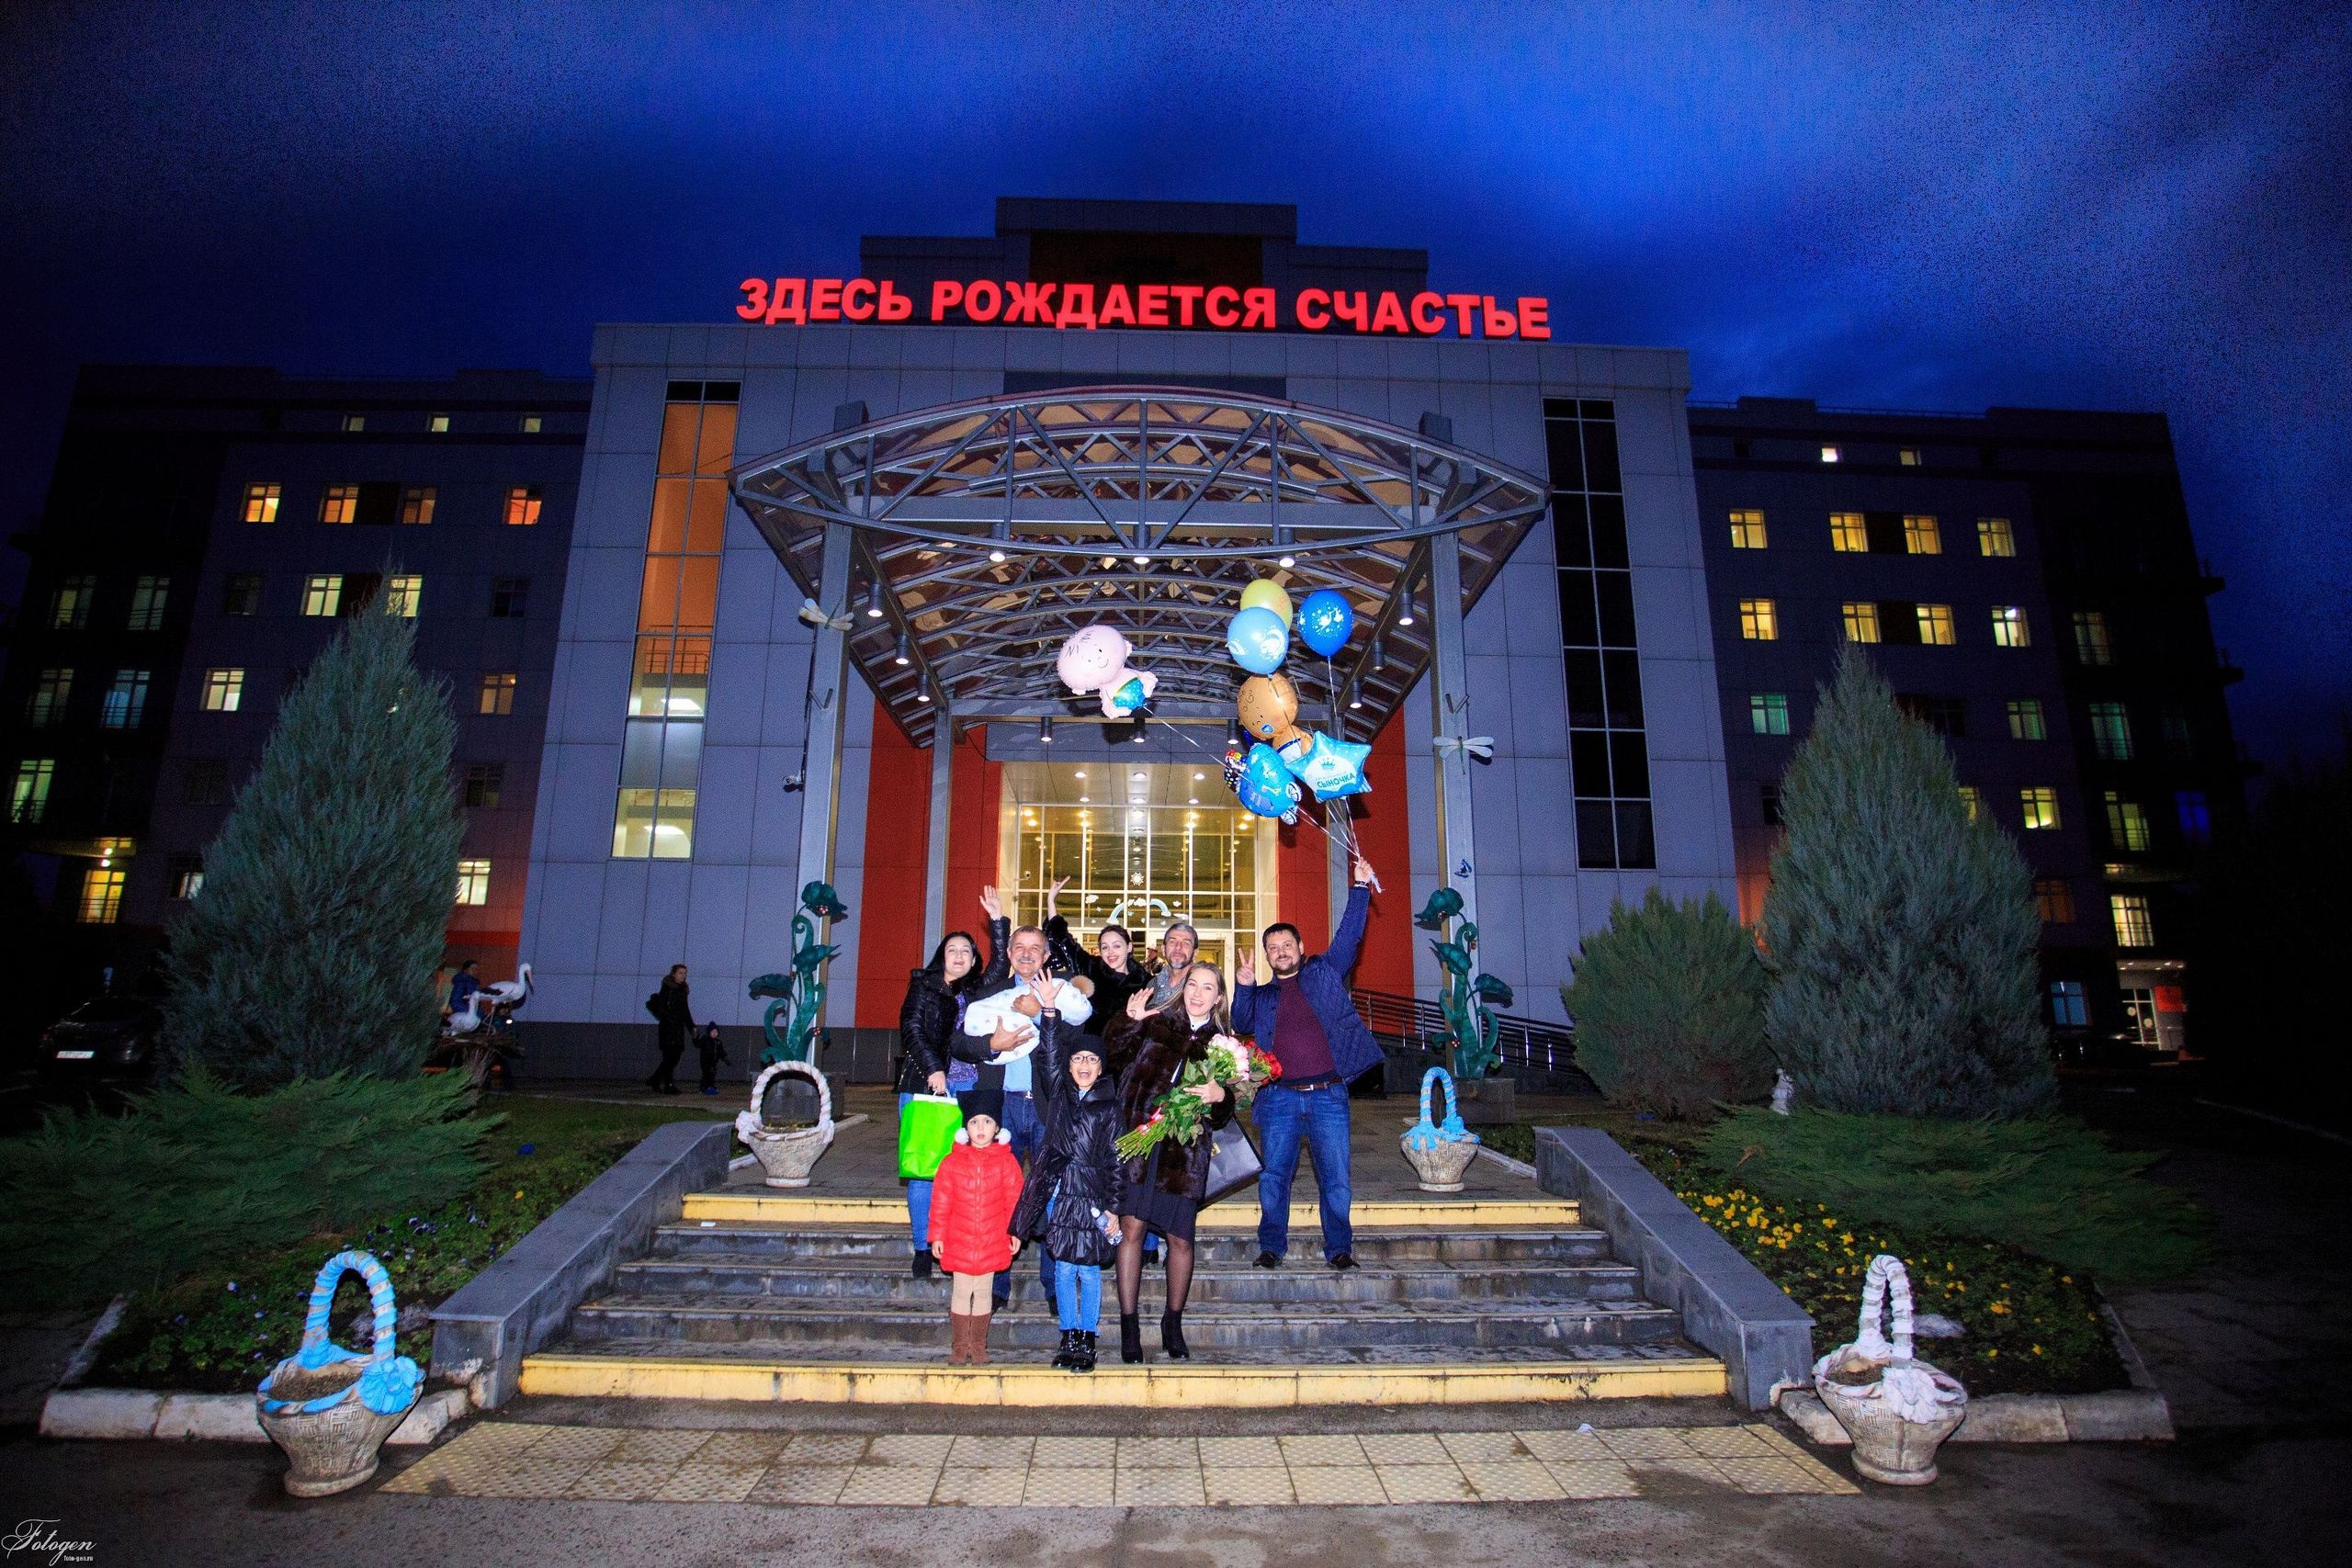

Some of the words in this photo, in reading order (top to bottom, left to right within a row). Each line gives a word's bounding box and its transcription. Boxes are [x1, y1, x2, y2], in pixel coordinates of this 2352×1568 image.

[736, 278, 913, 325] ЗДЕСЬ
[931, 279, 1277, 330] РОЖДАЕТСЯ
[1295, 288, 1552, 339] СЧАСТЬЕ
[1317, 773, 1356, 788] СЫНОЧКА
